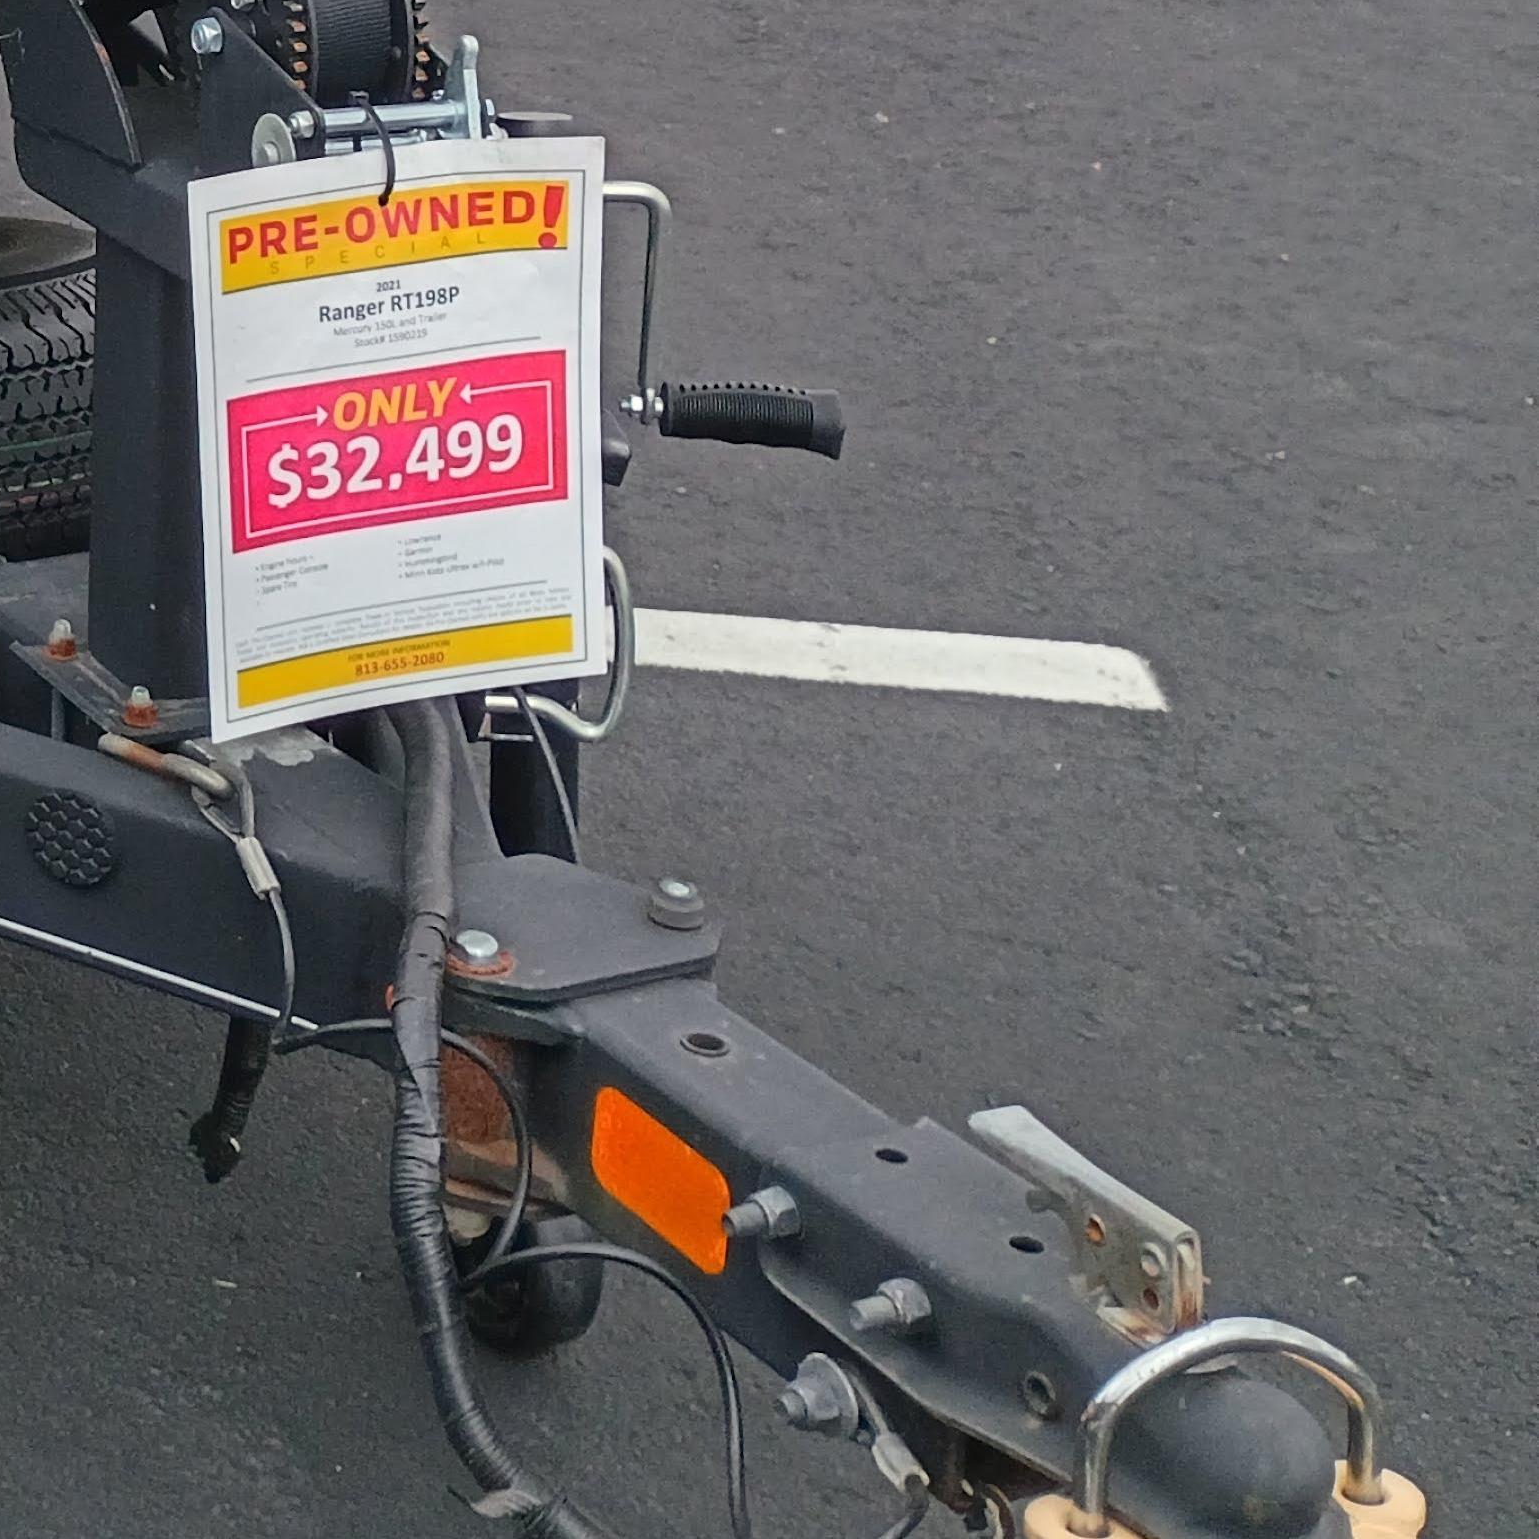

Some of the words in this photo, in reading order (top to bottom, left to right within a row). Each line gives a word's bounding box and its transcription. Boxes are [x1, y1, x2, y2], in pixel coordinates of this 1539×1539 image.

[228, 184, 567, 265] PRE-OWNED!
[318, 301, 385, 323] Ranger
[391, 285, 460, 312] RT198P
[375, 279, 402, 293] 2021
[399, 316, 417, 328] and
[332, 377, 457, 431] ONLY
[267, 414, 524, 509] $32,499
[354, 651, 445, 677] 813-655-2080
